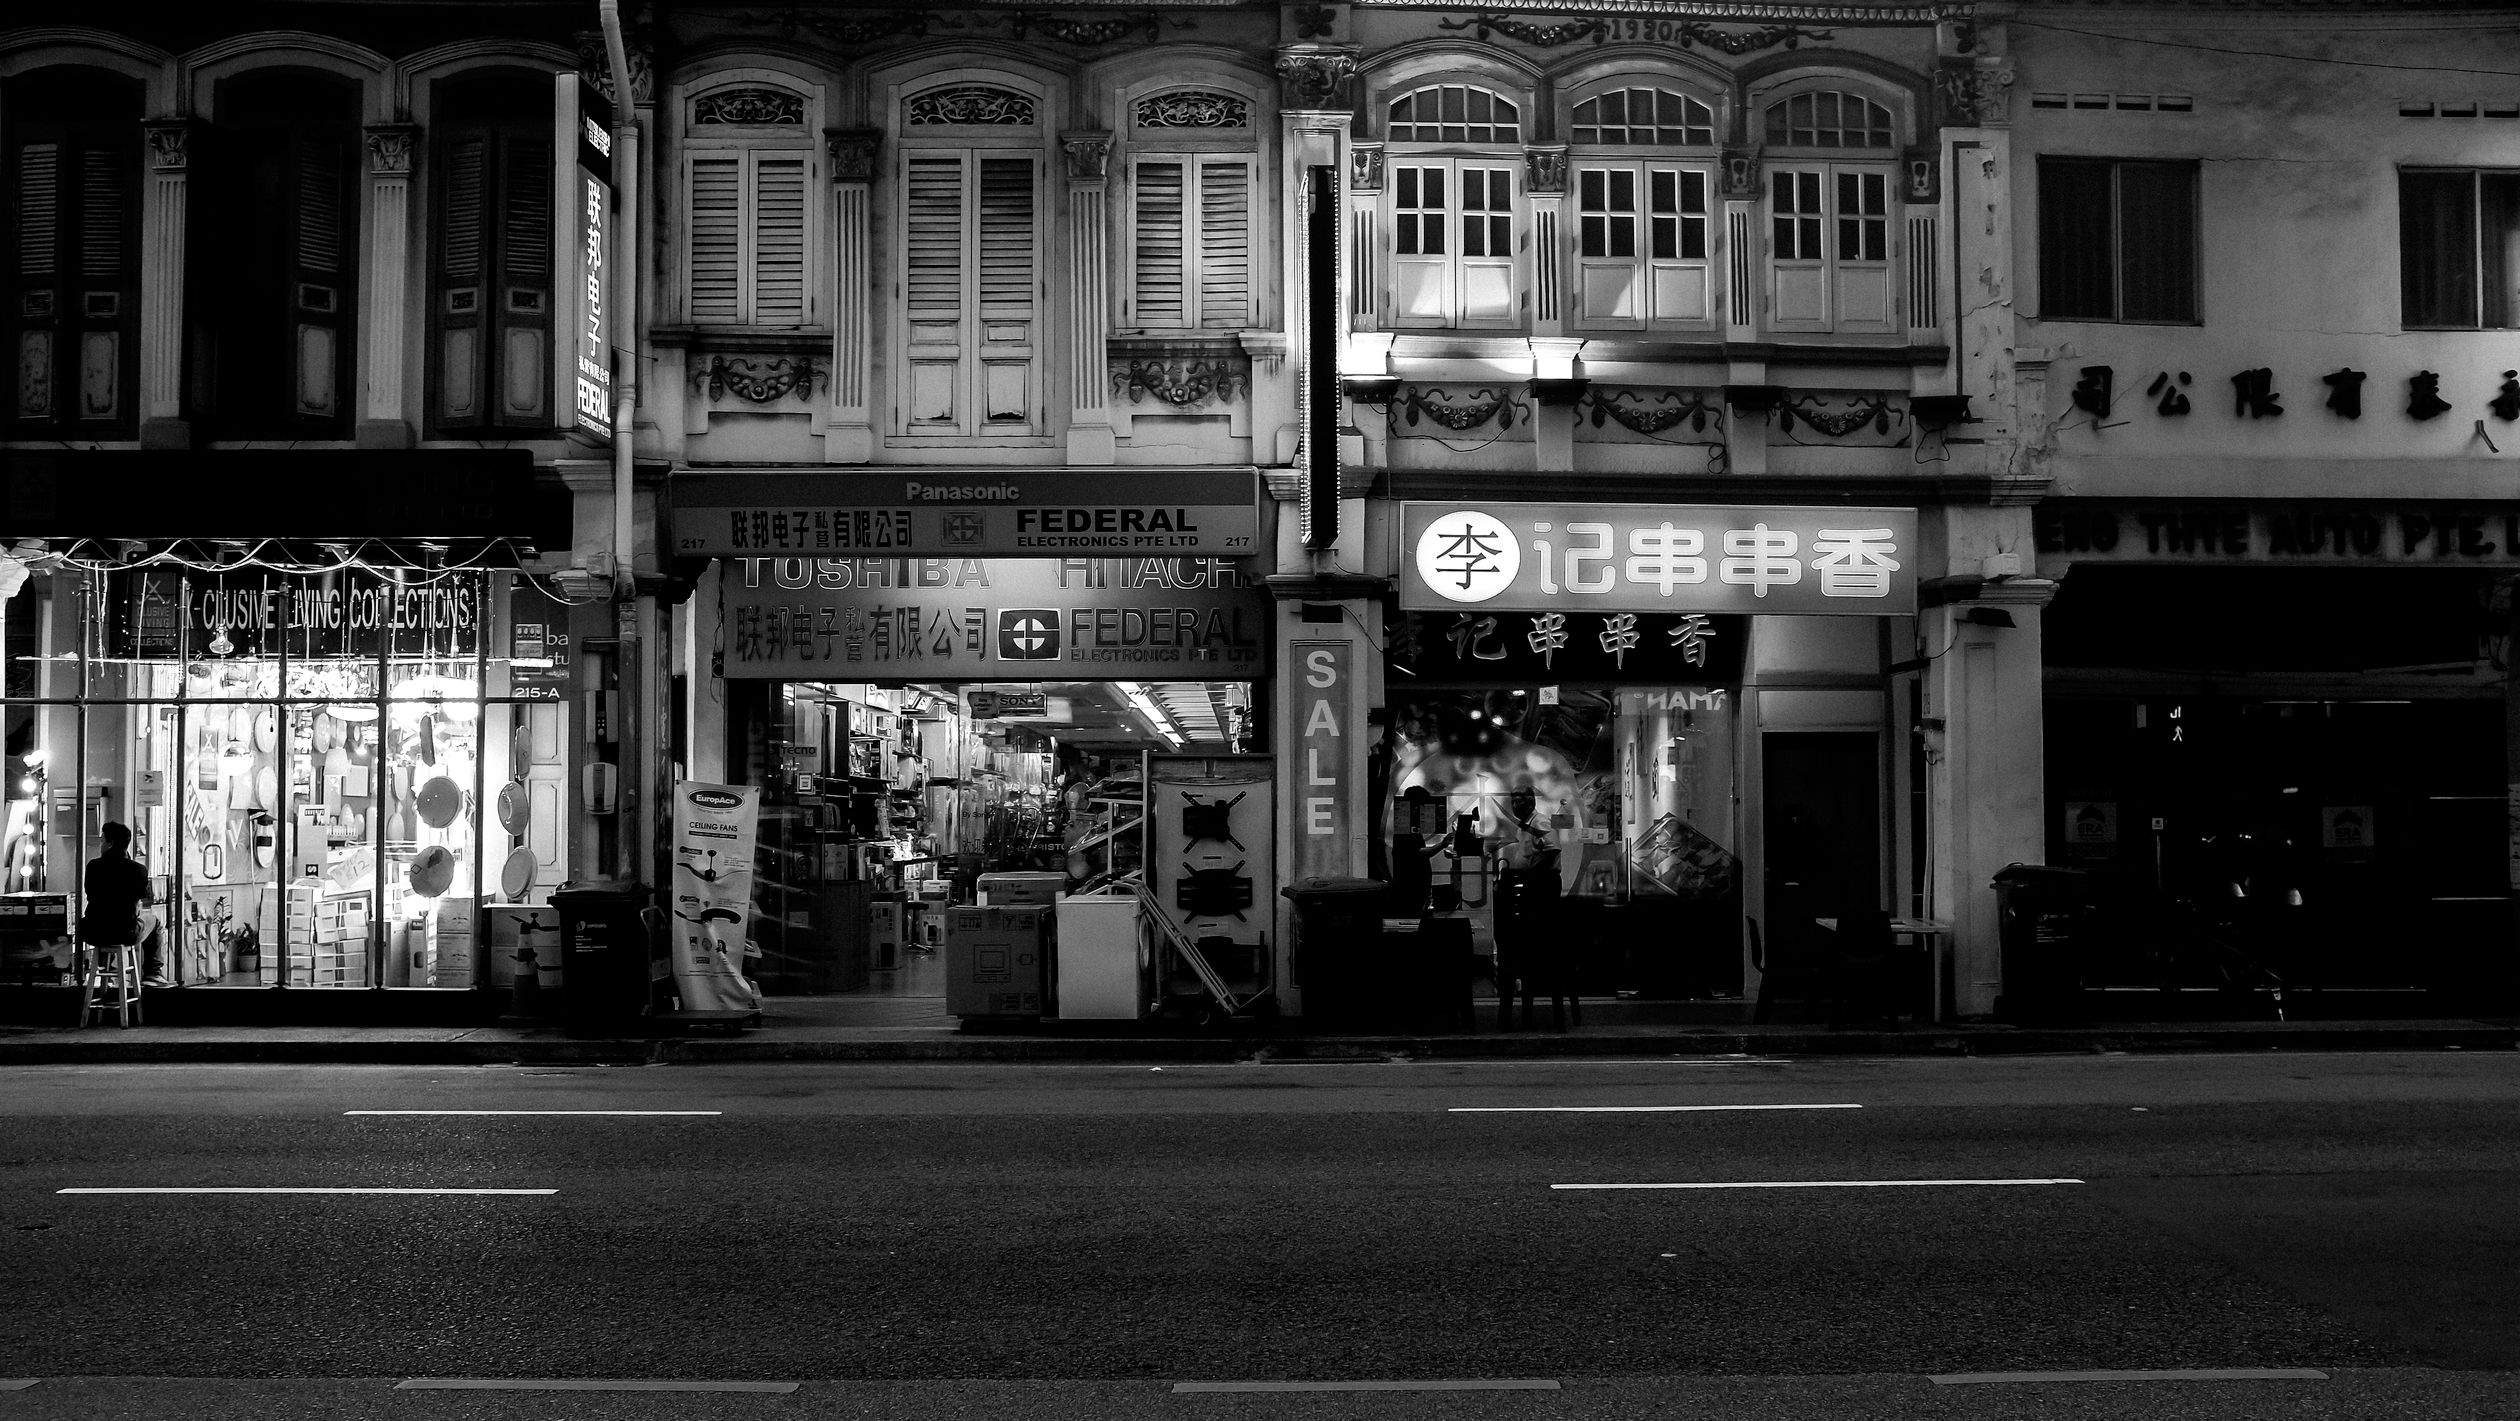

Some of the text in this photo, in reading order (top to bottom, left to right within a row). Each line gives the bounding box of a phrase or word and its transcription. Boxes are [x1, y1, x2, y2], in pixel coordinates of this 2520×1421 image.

[1611, 19, 1673, 41] 1920
[586, 178, 602, 358] 联邦电子
[577, 376, 611, 424] FEDERAL
[906, 482, 1020, 501] Panasonic
[1016, 508, 1198, 533] FEDERAL
[681, 538, 706, 549] 217
[1017, 535, 1199, 548] ELECTRONICS PTE LTD
[1225, 536, 1250, 547] 217
[2269, 511, 2381, 555] AUTO
[1435, 522, 1901, 598] 李记串串香
[734, 557, 992, 590] TOSHIBA
[286, 588, 341, 630] IVING
[349, 587, 478, 630] COLECTIONS.
[1070, 607, 1258, 648] FEDERAL
[1070, 648, 1181, 663] ELECTRONICS
[1188, 649, 1219, 662] PTE
[514, 687, 561, 699] 215-A
[1304, 650, 1341, 836] SALE
[696, 794, 736, 805] EuropAce
[689, 821, 738, 833] CEILING FANS
